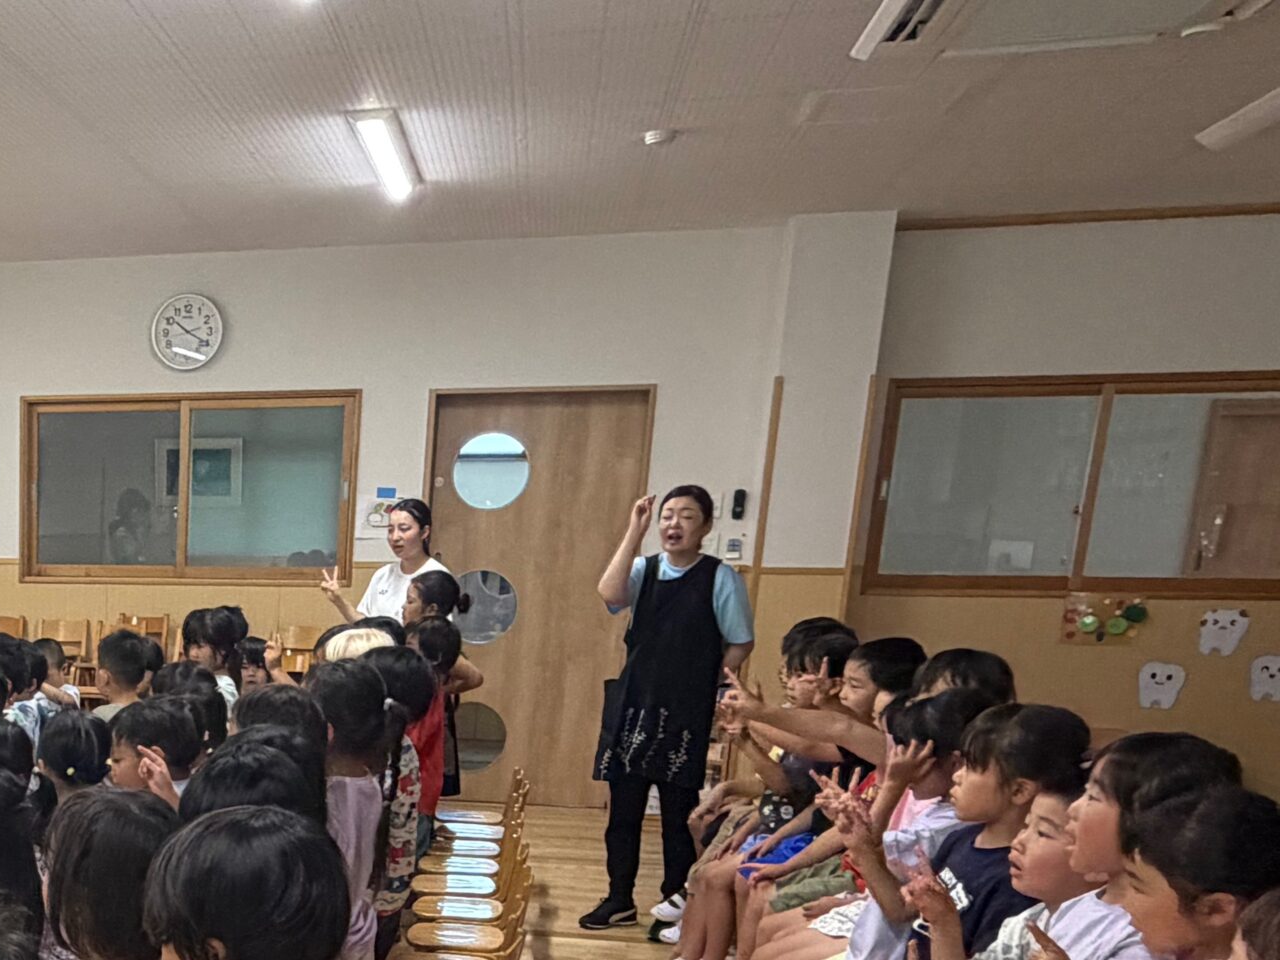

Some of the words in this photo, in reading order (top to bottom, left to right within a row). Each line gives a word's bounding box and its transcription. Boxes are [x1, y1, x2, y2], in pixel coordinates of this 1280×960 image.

[174, 307, 181, 316] 11
[184, 304, 193, 313] 12
[165, 316, 175, 326] 10
[203, 315, 210, 324] 2
[162, 328, 169, 337] 9
[206, 326, 213, 336] 3
[165, 340, 173, 349] 8
